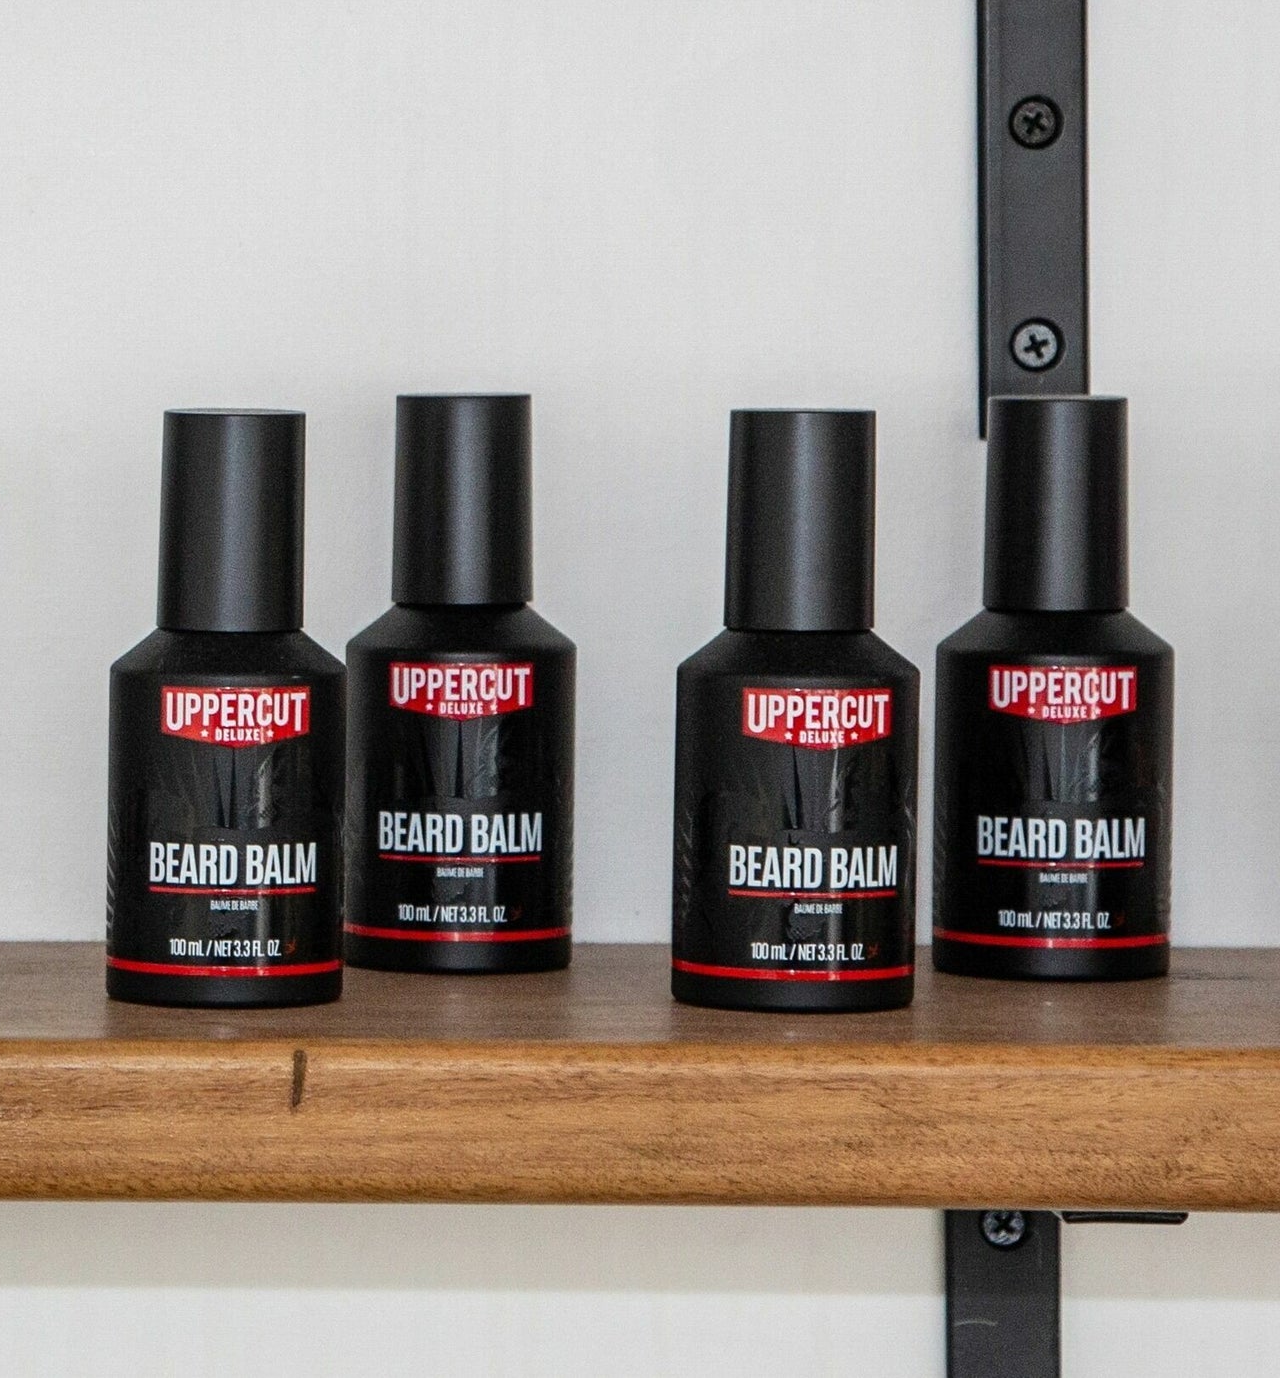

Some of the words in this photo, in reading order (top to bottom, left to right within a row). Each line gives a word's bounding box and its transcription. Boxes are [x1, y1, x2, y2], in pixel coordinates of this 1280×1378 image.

[394, 668, 531, 704] UPPERCUT
[992, 672, 1134, 708] UPPERCUT
[166, 692, 306, 729] UPPERCUT
[439, 701, 483, 715] DELUXE
[747, 694, 889, 734] UPPERCUT
[1042, 705, 1087, 719] DELUXE
[215, 727, 261, 741] DELUXE
[799, 730, 845, 744] DELUXE
[379, 811, 468, 852] BEARD
[475, 811, 543, 852] BALM
[977, 816, 1067, 858] BEARD
[1075, 816, 1145, 858] BALM
[150, 844, 238, 886] BEARD
[246, 843, 317, 884] BALM
[729, 847, 823, 887] BEARD
[830, 846, 897, 886] BALM
[170, 938, 188, 956] 100
[190, 938, 204, 955] mL
[253, 939, 266, 957] FL.
[268, 939, 281, 957] OZ.
